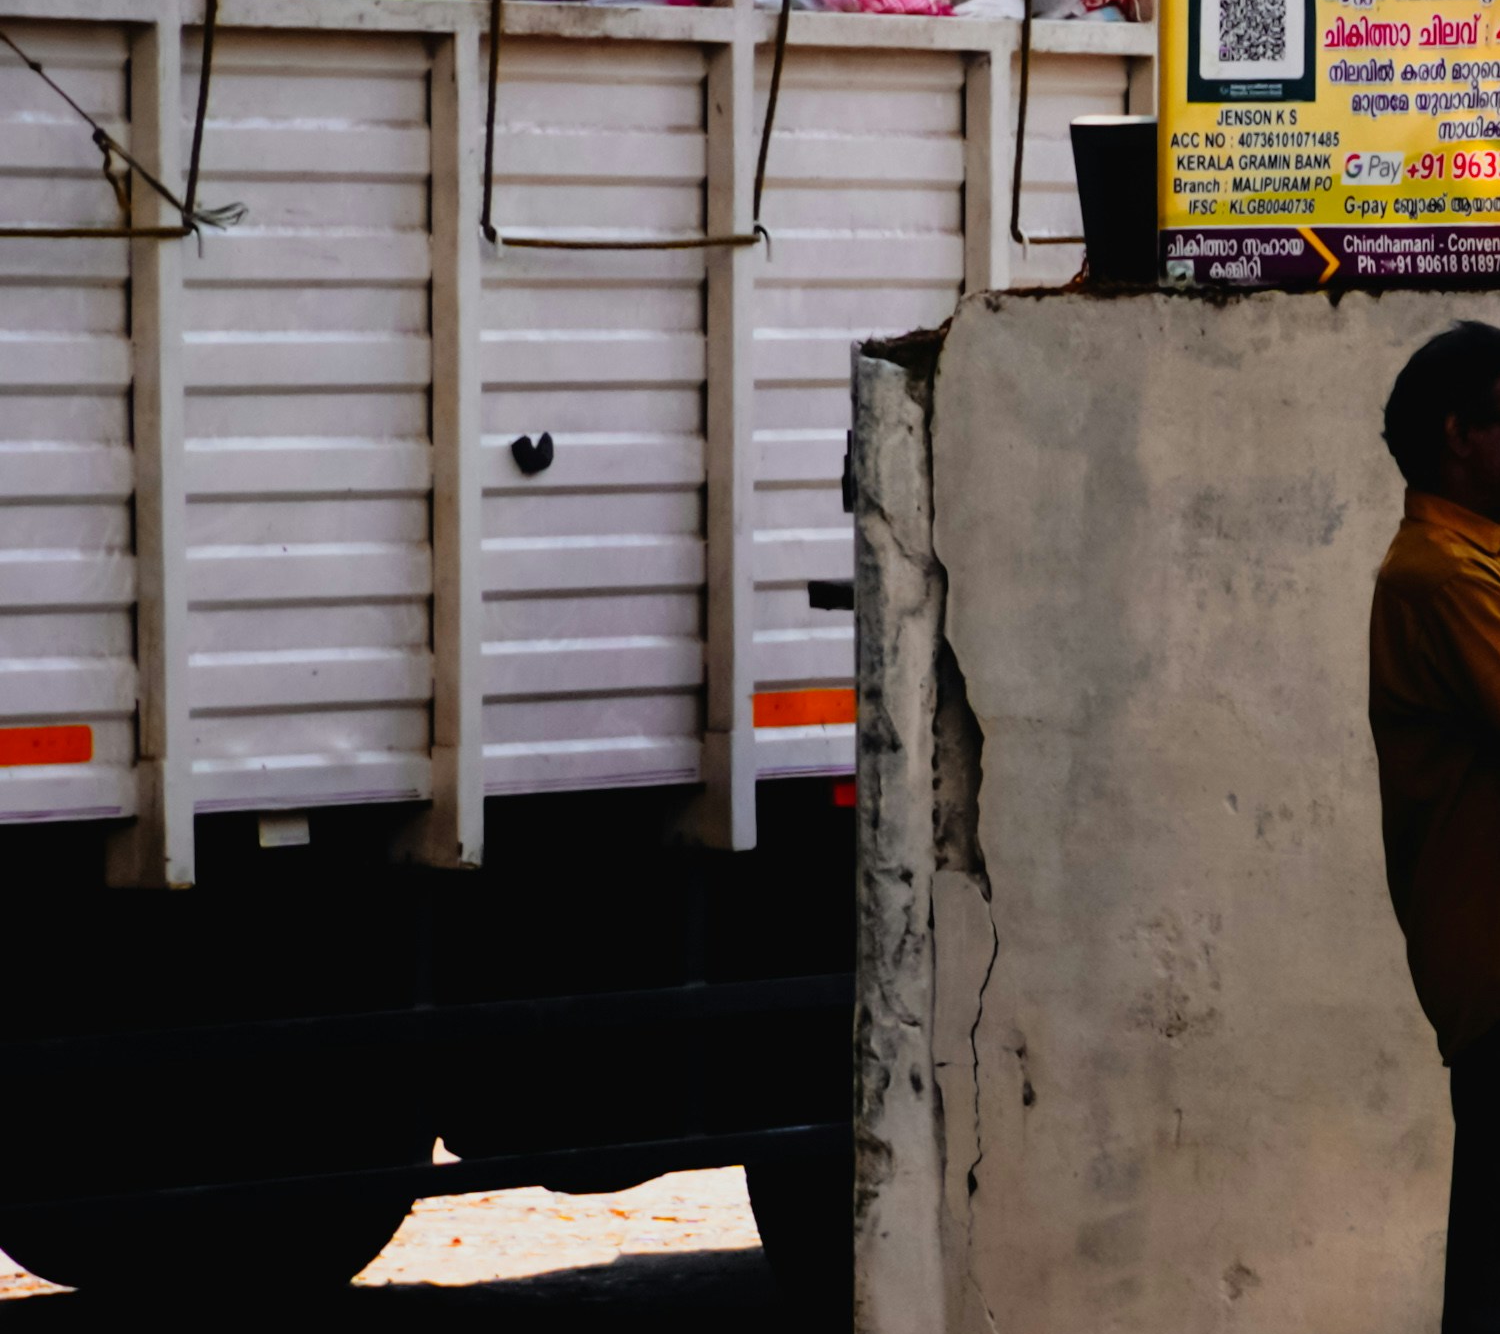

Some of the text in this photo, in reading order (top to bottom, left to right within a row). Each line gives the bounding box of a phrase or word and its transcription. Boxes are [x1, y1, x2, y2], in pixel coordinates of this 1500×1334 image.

[1216, 109, 1298, 126] JENSON K S
[1170, 132, 1200, 148] ACC
[1205, 132, 1226, 148] NO
[1238, 131, 1340, 148] 40736101071485
[1177, 153, 1332, 171] KERALA GRAMIN BANK
[1367, 155, 1401, 184] Pay
[1406, 153, 1445, 179] +91
[1173, 177, 1220, 193] Branch
[1232, 176, 1310, 193] MALIPURAM
[1314, 175, 1333, 192] PO
[1189, 199, 1218, 215] IFSC
[1344, 195, 1387, 218] G-pay
[1343, 233, 1435, 253] Chindhamani
[1358, 256, 1377, 274] Ph
[1416, 254, 1458, 274] 90618
